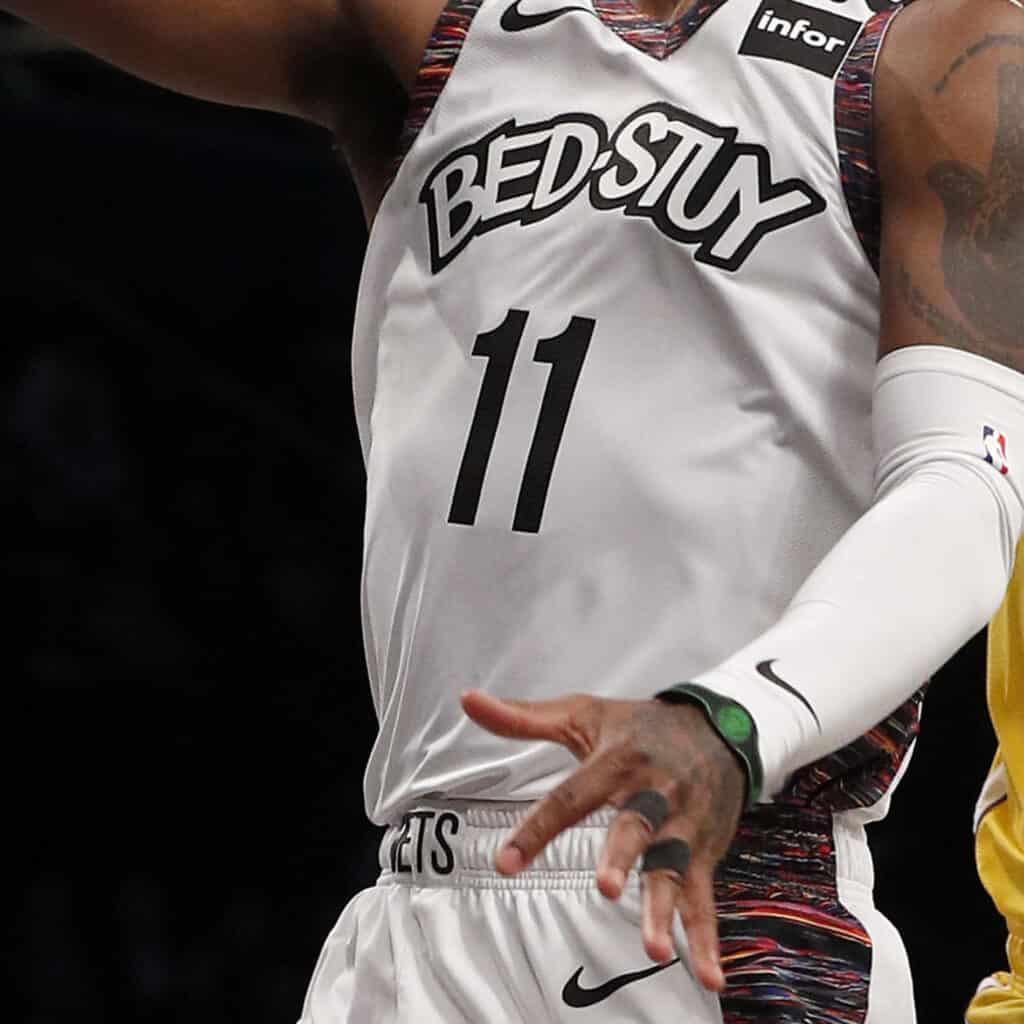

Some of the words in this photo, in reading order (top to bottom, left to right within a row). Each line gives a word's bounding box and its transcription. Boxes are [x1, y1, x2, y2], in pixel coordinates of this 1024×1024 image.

[758, 8, 846, 55] infor
[447, 307, 597, 535] 11
[390, 810, 459, 875] ETS
